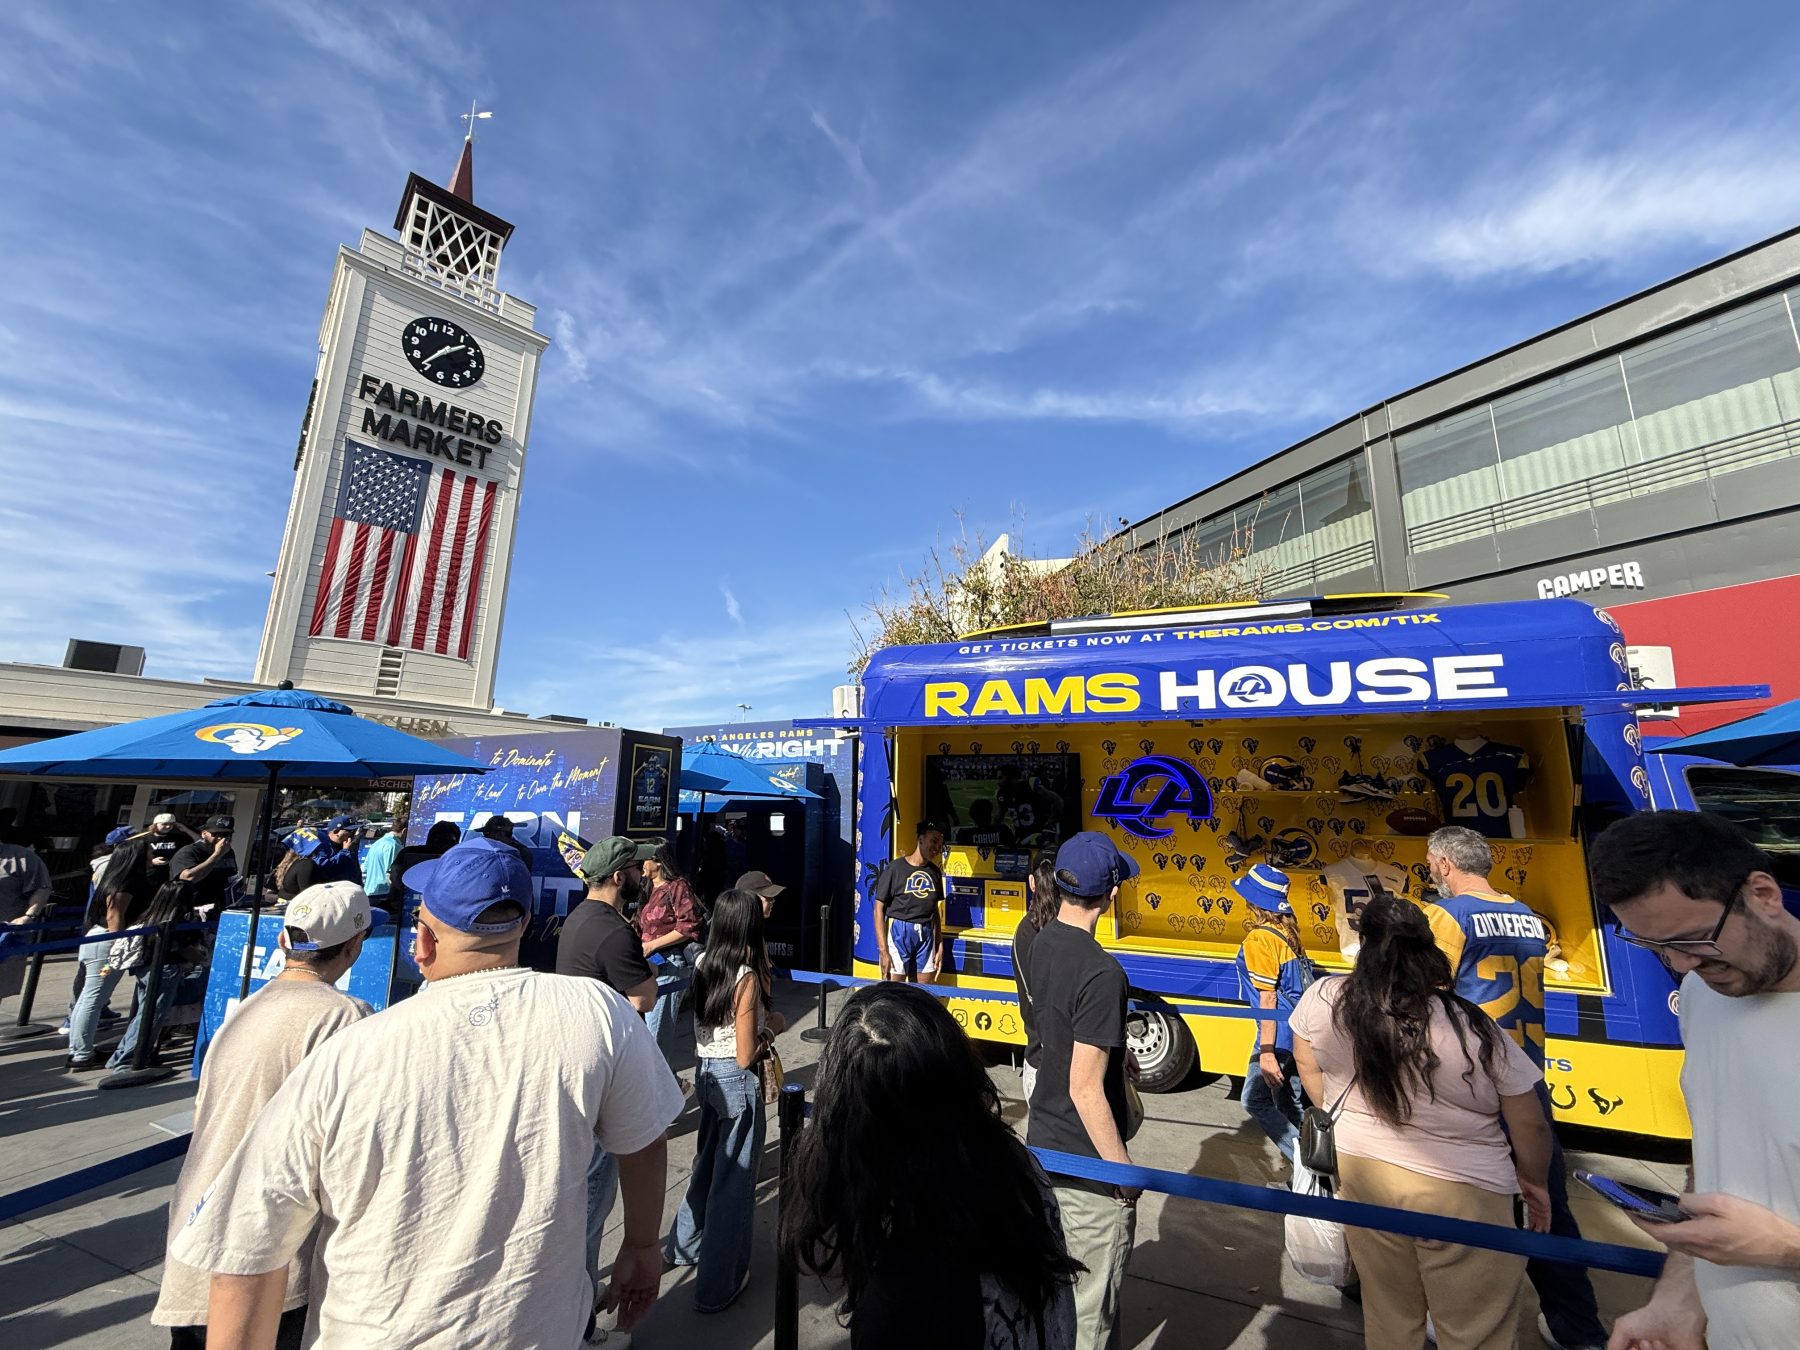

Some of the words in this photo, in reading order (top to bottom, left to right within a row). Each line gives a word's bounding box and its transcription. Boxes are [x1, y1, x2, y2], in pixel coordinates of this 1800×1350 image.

[415, 326, 427, 336] 10
[429, 322, 438, 332] 11
[442, 325, 454, 336] 12
[411, 336, 419, 345] 9
[460, 335, 464, 343] 1
[412, 349, 421, 358] 8
[467, 347, 475, 356] 2
[423, 362, 431, 370] 7
[469, 360, 477, 368] 3
[436, 371, 445, 379] 6
[452, 373, 460, 382] 5
[463, 370, 471, 378] 4
[359, 374, 503, 444] FARMERS
[361, 407, 492, 470] MARKET
[1537, 561, 1644, 599] CAMPER
[958, 645, 993, 655] GET
[1001, 638, 1078, 651] TICKETS
[1086, 634, 1131, 646] NOW
[1140, 633, 1164, 642] AT
[1173, 613, 1441, 640] THERAMS.COM/TIX
[924, 672, 1141, 718] RAMS
[1159, 654, 1508, 711] HOUSE
[695, 734, 717, 743] LOS
[721, 731, 774, 741] ANGELES
[779, 729, 814, 738] RAMS
[757, 738, 845, 759] RIGHT
[502, 749, 556, 772] Dominate
[526, 780, 548, 801] Own
[549, 771, 563, 797] the
[564, 756, 610, 789] Moment
[368, 779, 413, 789] TASCHEN
[1445, 772, 1508, 817] 20
[636, 805, 662, 813] RIGHT
[973, 832, 999, 844] CORUM
[1472, 912, 1546, 939] DICKERSON
